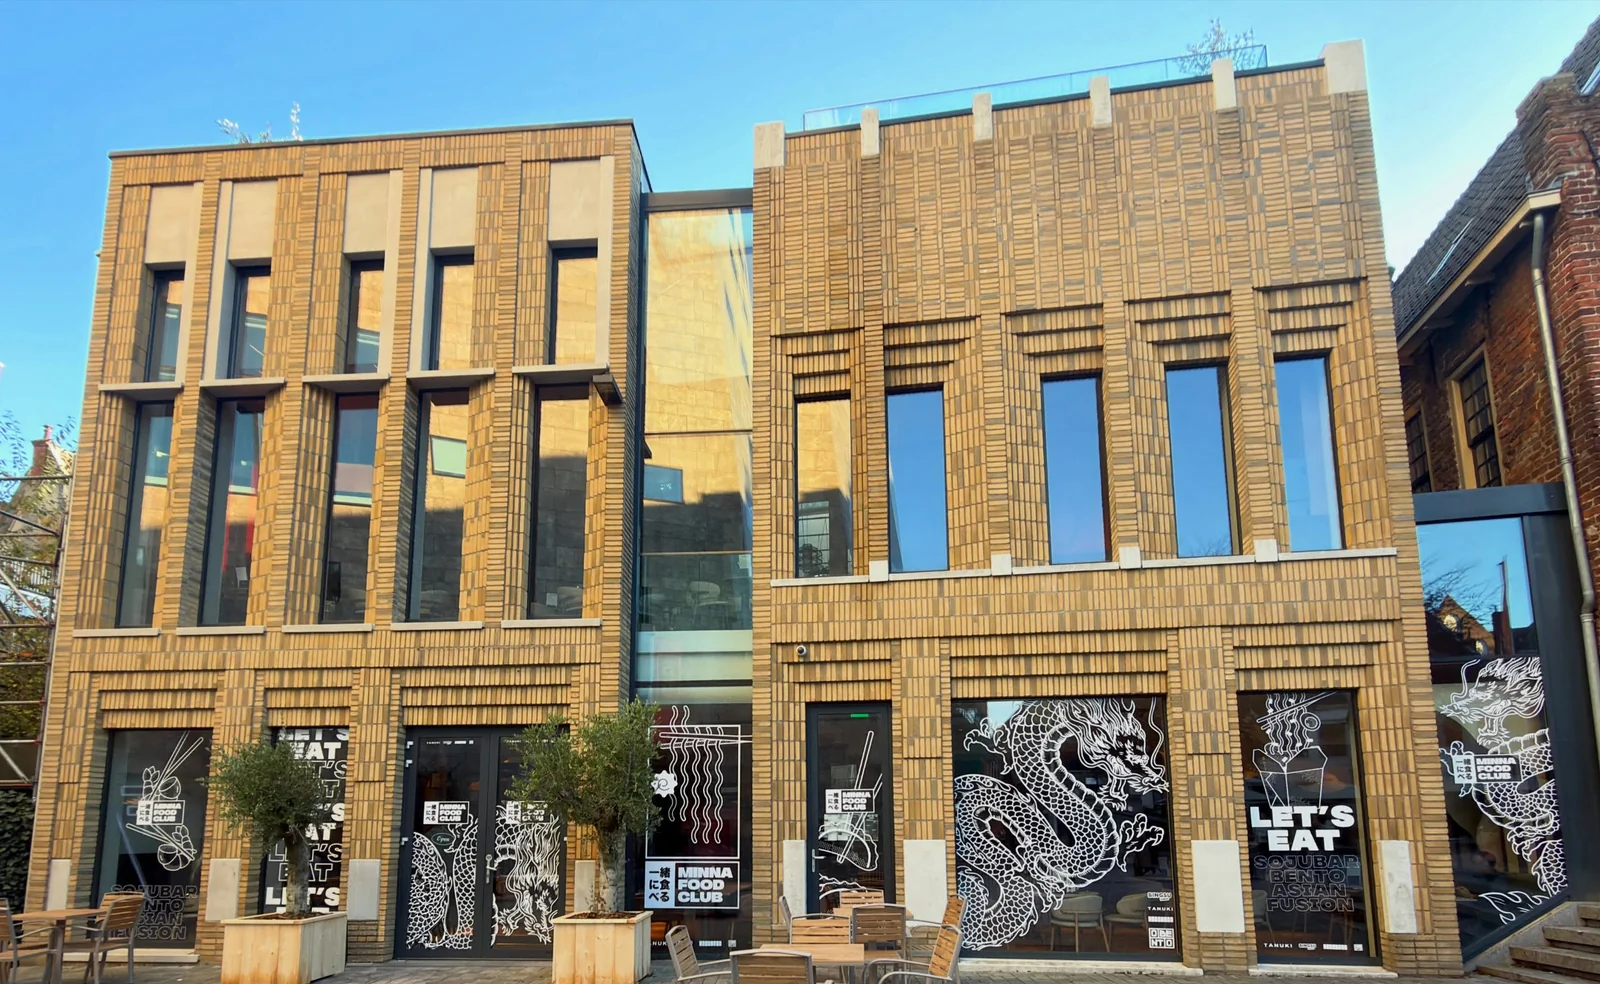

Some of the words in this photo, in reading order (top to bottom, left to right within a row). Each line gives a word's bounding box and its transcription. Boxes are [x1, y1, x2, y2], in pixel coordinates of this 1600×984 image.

[278, 729, 349, 741] LETS
[290, 742, 341, 760] EAT
[1250, 805, 1355, 828] LET'S
[1267, 829, 1340, 851] EAT
[268, 842, 343, 863] LT'S
[1253, 854, 1360, 869] SOJUBAR
[278, 863, 334, 882] ET
[677, 867, 733, 878] MINNA
[1269, 869, 1346, 883] BENTO
[677, 879, 725, 891] FOOD
[1271, 883, 1347, 898] ASIAN
[265, 887, 341, 907] LT'S
[677, 891, 723, 903] CLUB
[1265, 898, 1355, 912] FUSION
